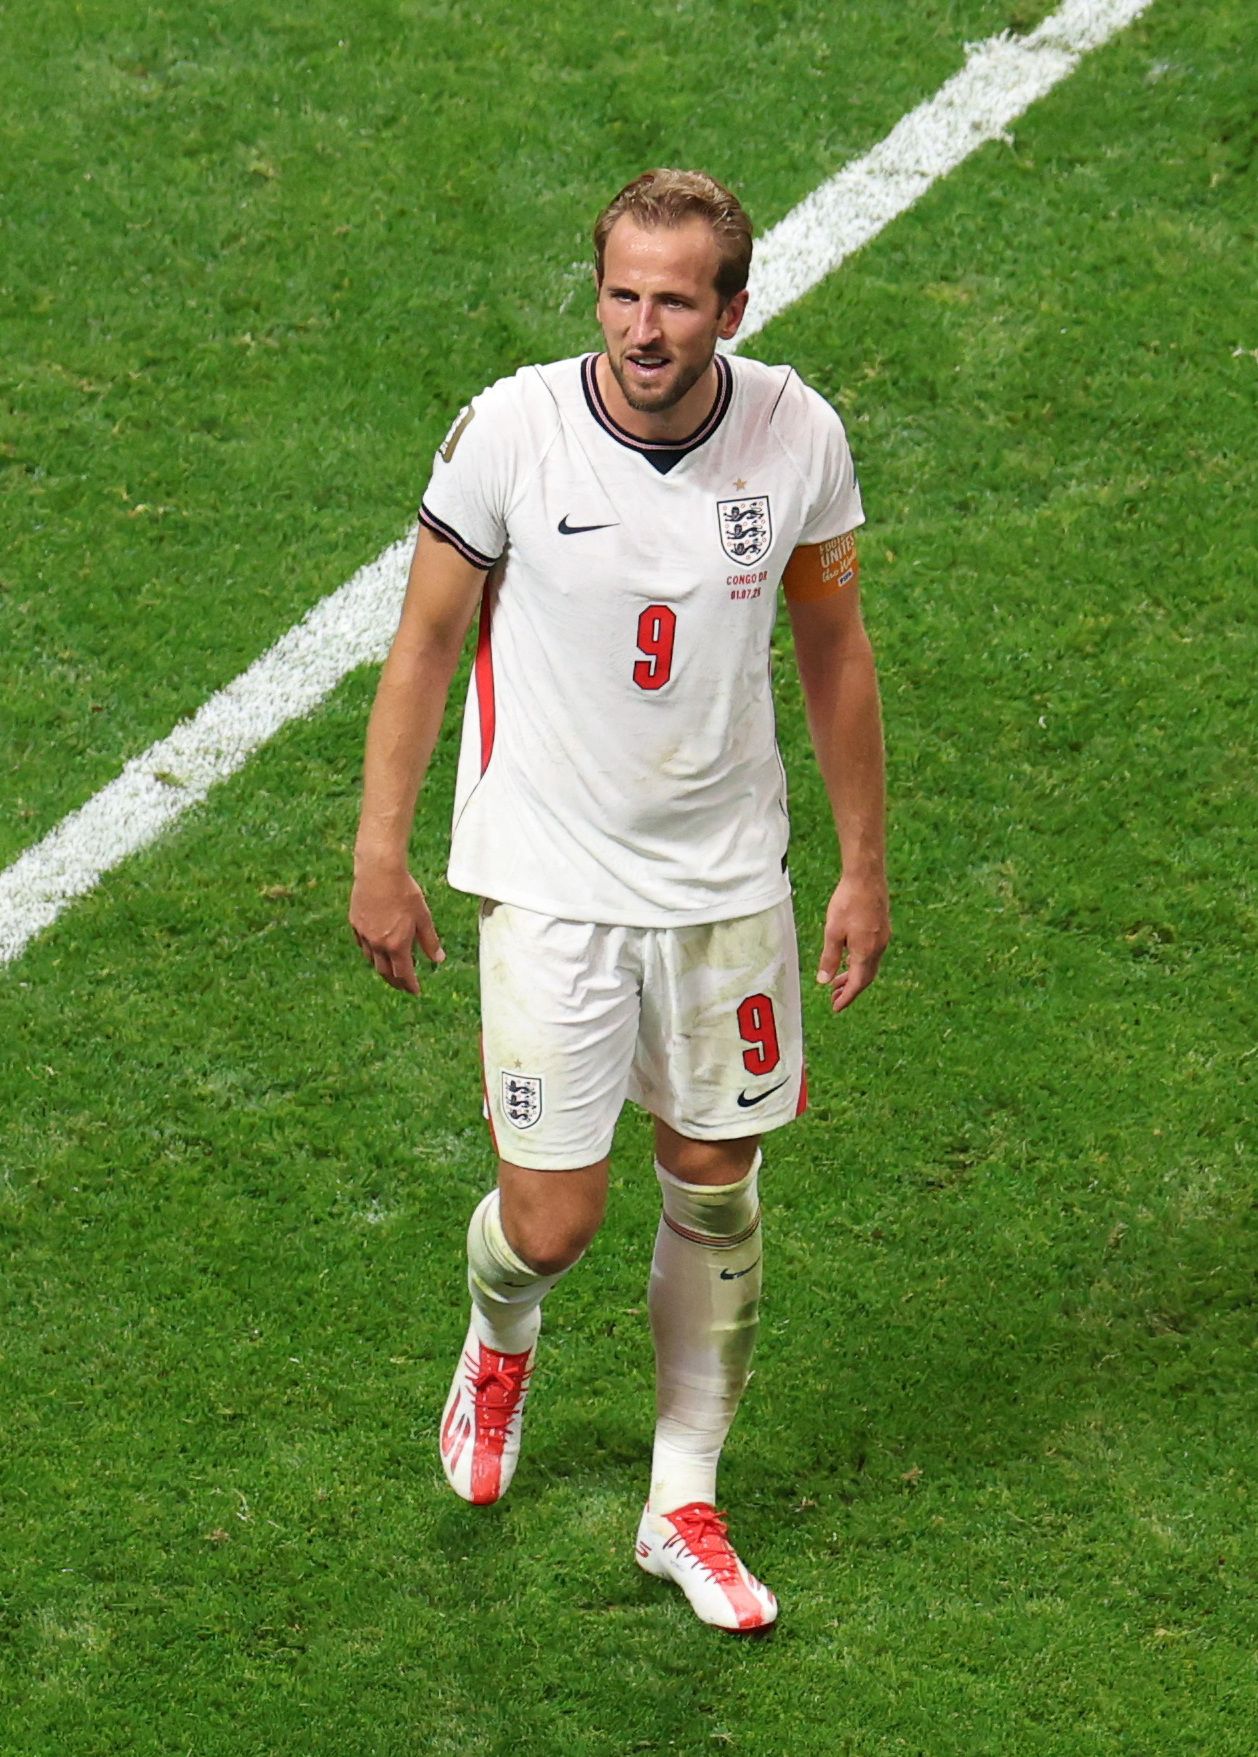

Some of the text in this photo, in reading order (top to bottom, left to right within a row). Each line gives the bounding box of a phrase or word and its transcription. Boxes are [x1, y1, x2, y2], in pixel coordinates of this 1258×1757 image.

[726, 573, 757, 586] CONGO
[632, 604, 677, 691] 9
[736, 993, 781, 1076] 9
